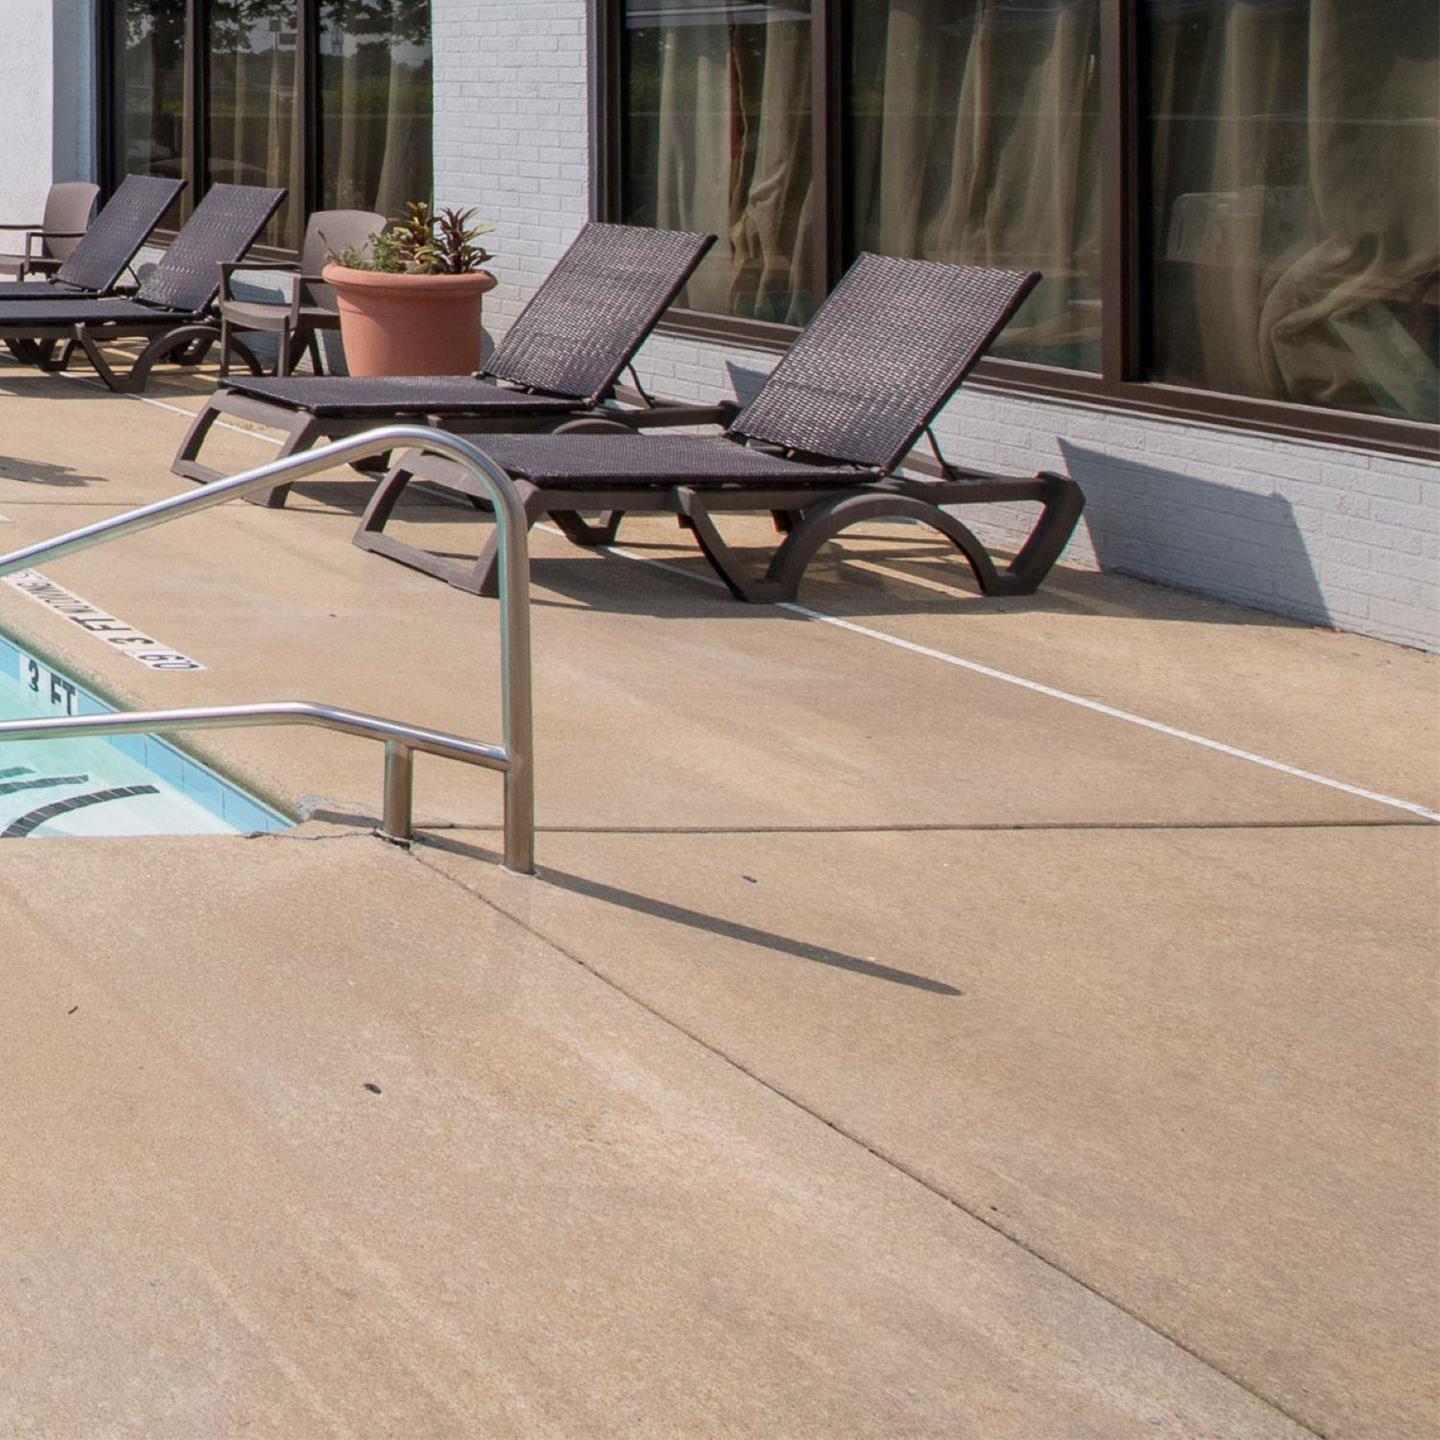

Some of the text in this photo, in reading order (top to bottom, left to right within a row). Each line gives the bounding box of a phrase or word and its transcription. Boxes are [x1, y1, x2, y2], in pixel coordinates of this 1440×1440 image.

[69, 615, 132, 631] FT
[107, 636, 154, 645] 3
[28, 658, 76, 717] 3 FT
